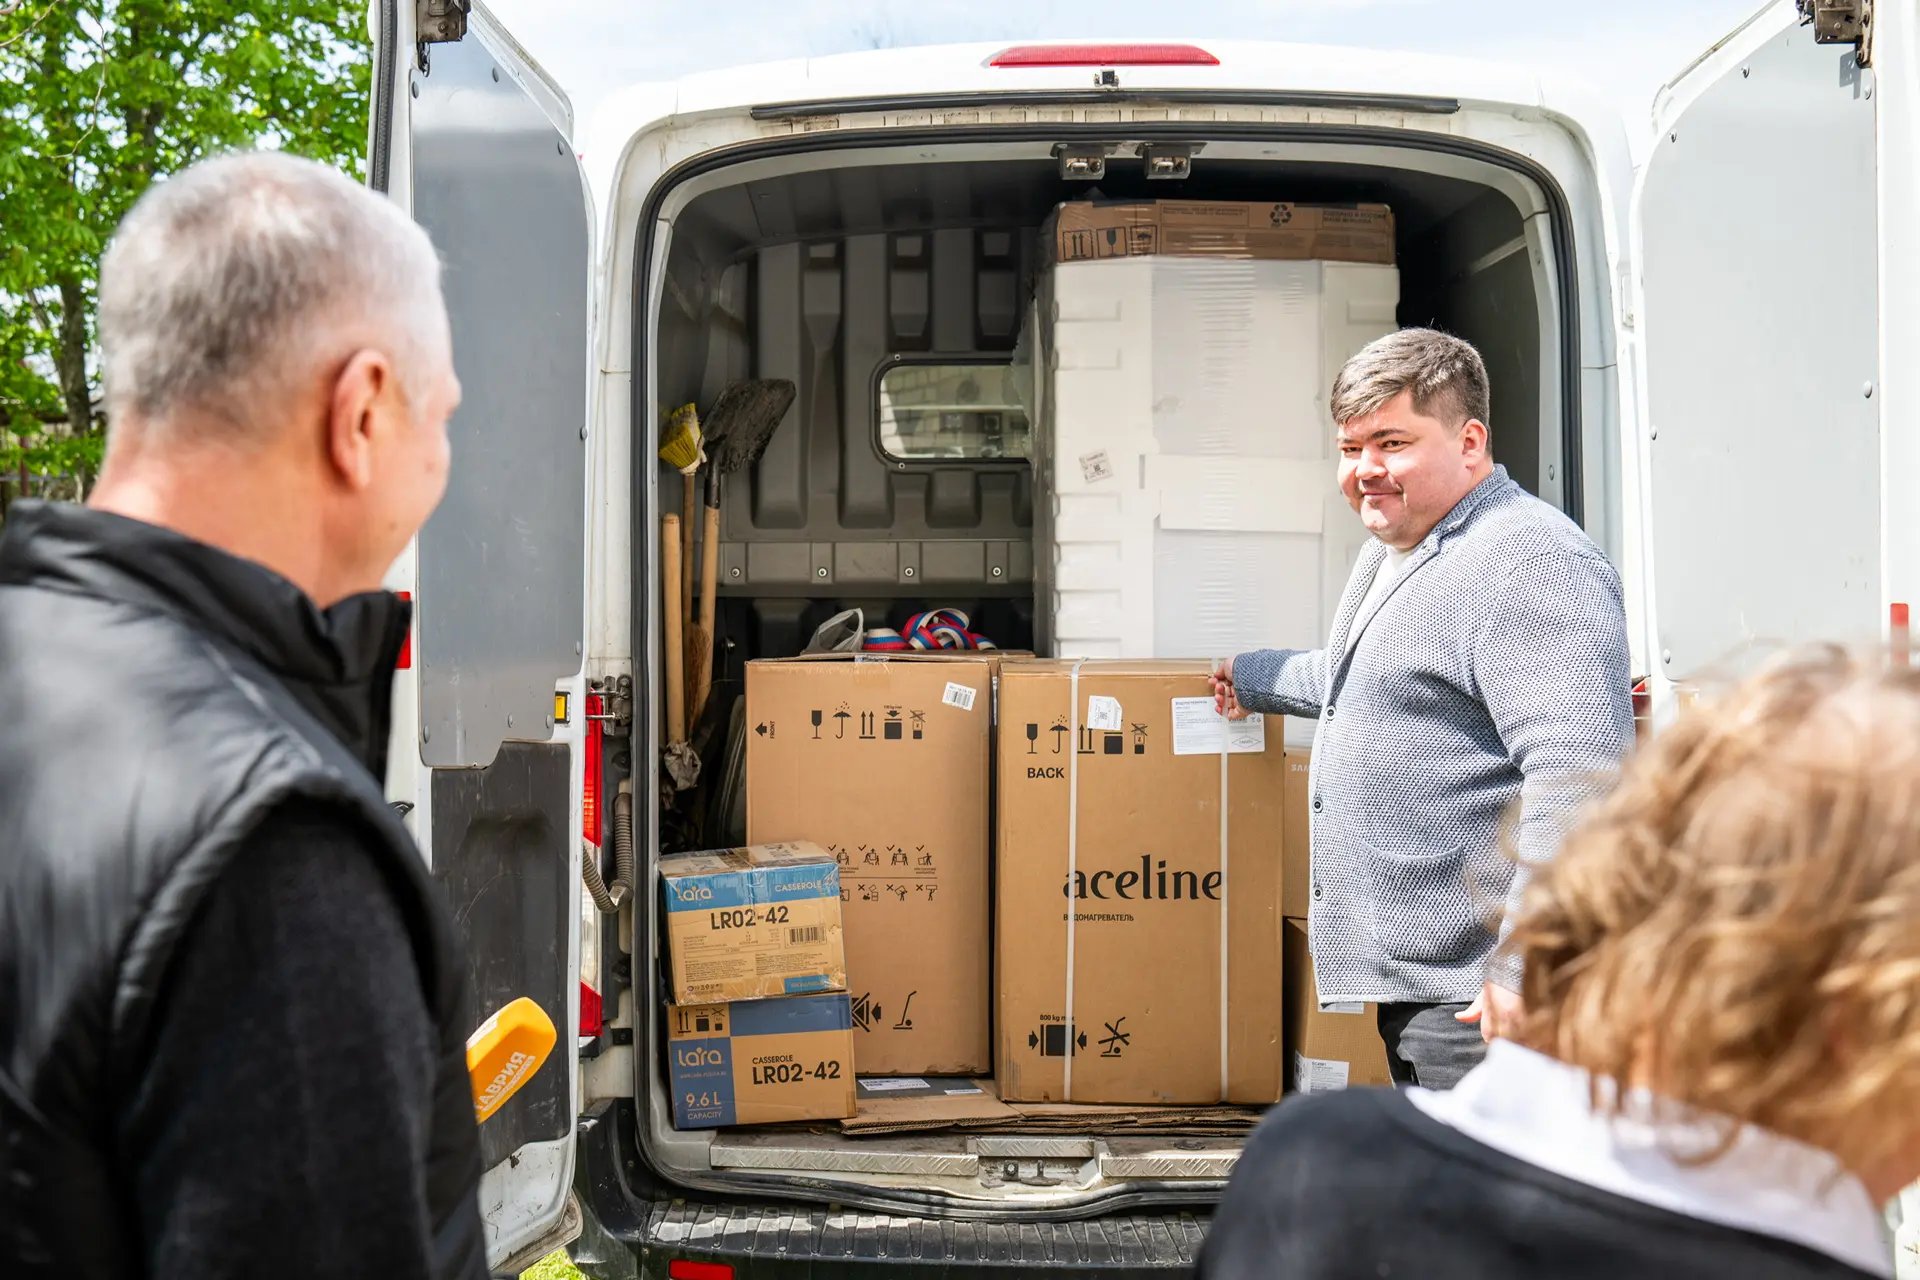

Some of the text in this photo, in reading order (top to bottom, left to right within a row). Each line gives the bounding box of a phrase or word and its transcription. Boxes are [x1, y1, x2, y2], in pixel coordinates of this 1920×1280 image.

[1027, 767, 1065, 779] BACK
[1063, 854, 1222, 900] aceline
[774, 880, 822, 893] CASSEROLE
[711, 906, 789, 930] LR02-42
[1063, 913, 1134, 922] ВДОНАГРЕВАТЕЛЬ
[1052, 1014, 1060, 1022] kg
[678, 1047, 723, 1067] lara
[752, 1054, 793, 1065] CASSEROLE
[752, 1060, 841, 1085] LR02-42
[686, 1091, 722, 1108] 9.6 L
[687, 1111, 722, 1120] CAPACITY
